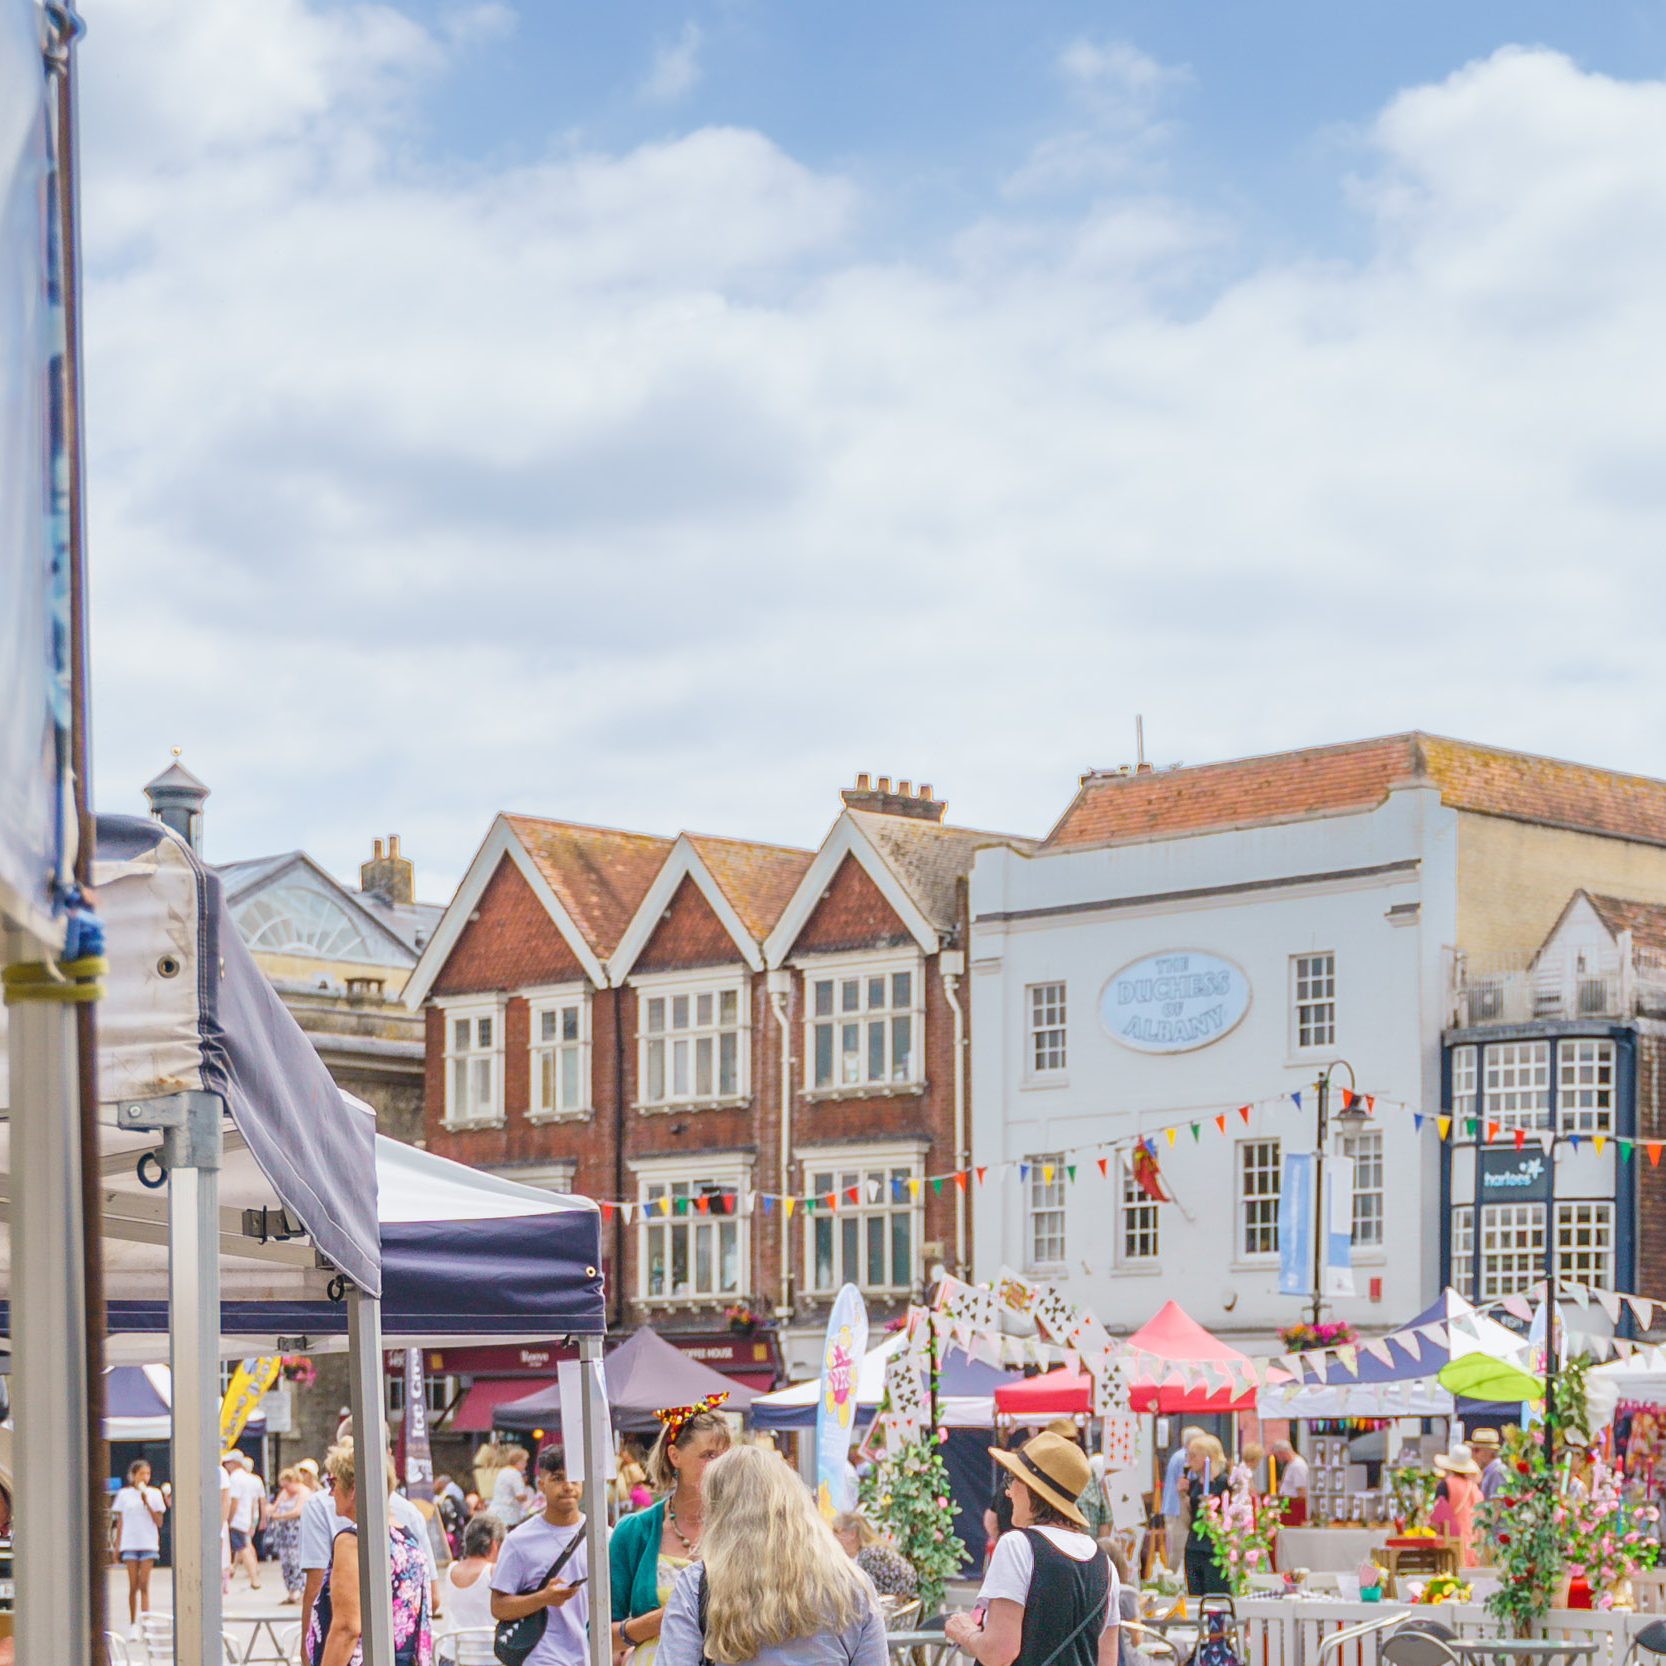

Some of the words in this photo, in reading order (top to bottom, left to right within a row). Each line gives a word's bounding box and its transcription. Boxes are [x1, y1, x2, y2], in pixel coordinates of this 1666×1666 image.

[1155, 956, 1189, 975] THE
[1117, 970, 1231, 1006] DUCHESS
[1122, 1003, 1225, 1043] ALBANY
[1162, 1002, 1184, 1018] OF
